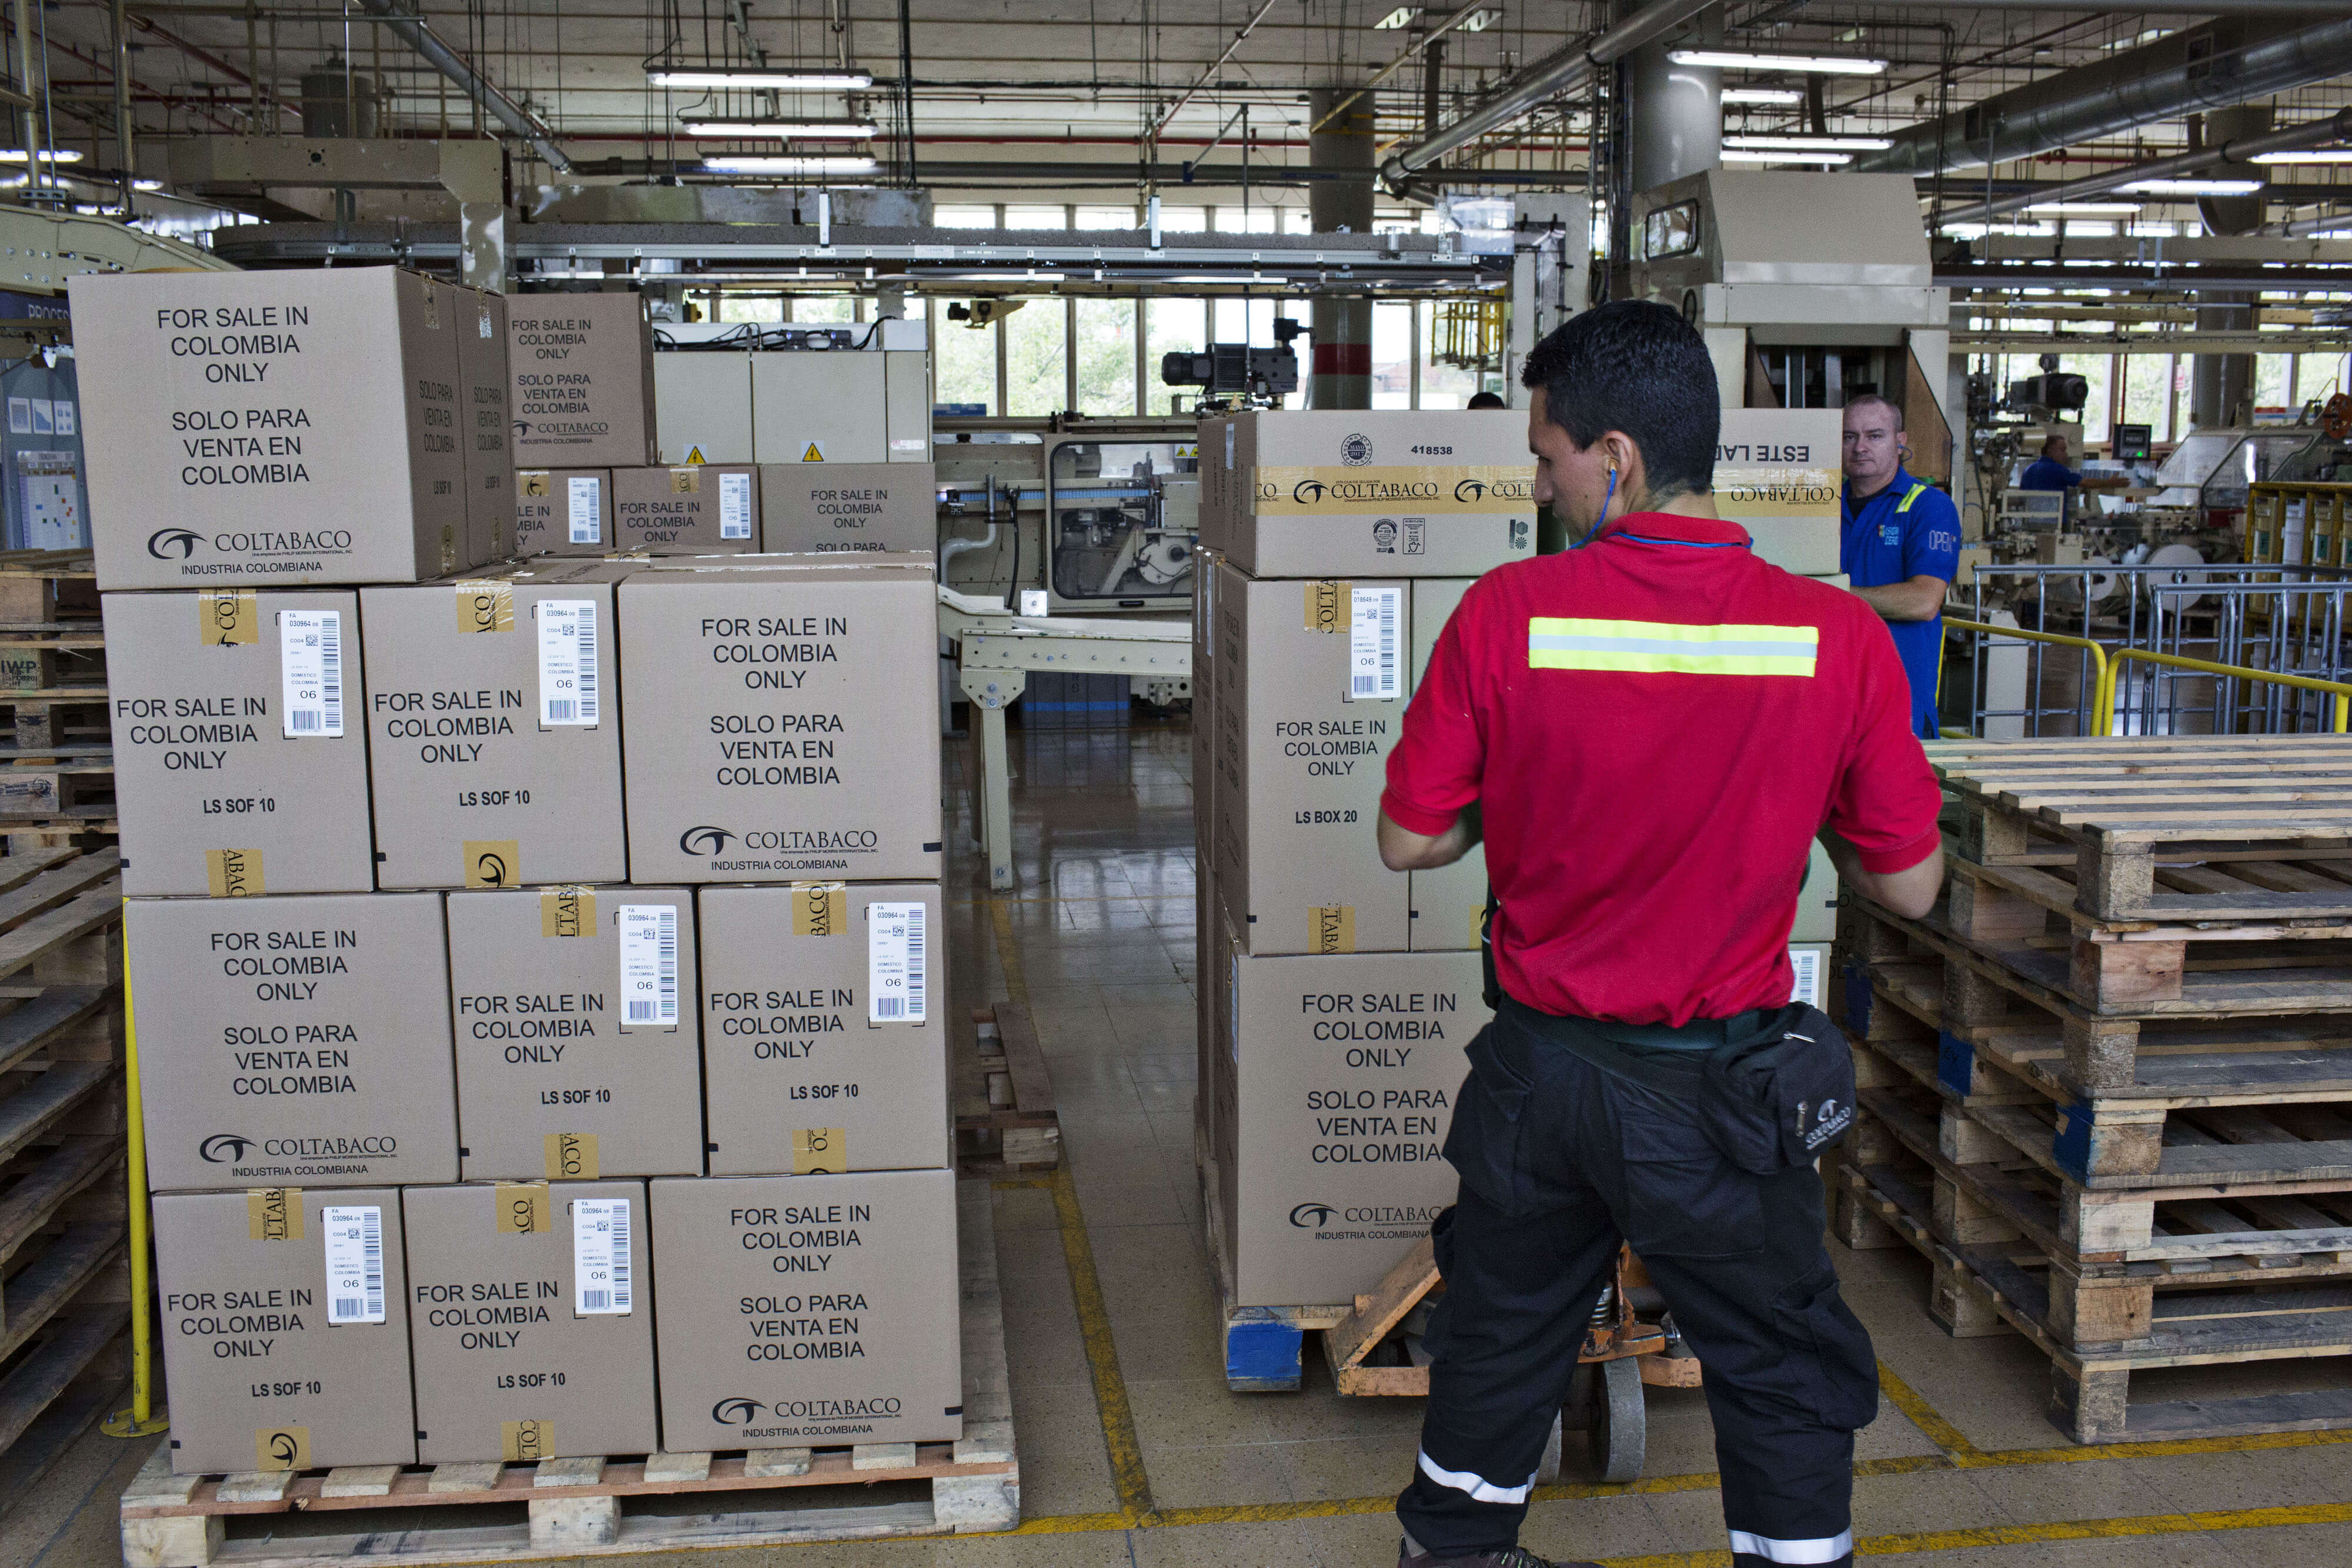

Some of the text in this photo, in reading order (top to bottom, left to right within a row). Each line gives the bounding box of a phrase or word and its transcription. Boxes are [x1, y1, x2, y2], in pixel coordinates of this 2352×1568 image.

[158, 306, 308, 329] FOR SALE IN
[512, 319, 591, 331] FOR SALE IN
[171, 334, 300, 356] COLOMBIA
[519, 334, 586, 345] COLOMBIA
[536, 348, 570, 359] ONLY
[205, 363, 269, 383] ONLY
[518, 374, 591, 386] SOLO PARA
[419, 380, 453, 403] SOLO PARA
[523, 388, 586, 400] VENTA EN
[423, 407, 443, 426] VENTA
[522, 402, 590, 414] COLOMBIA
[172, 409, 311, 431] SOLO PARA
[537, 422, 609, 433] COLTABACO
[183, 436, 301, 458] VENTA EN
[424, 434, 455, 452] COLOMBIA
[1411, 445, 1452, 455] 418538
[1716, 445, 1750, 462] LAD
[182, 463, 310, 486] COLOMBIA
[811, 490, 887, 501] FOR SALE IN
[1331, 483, 1438, 499] COLTABACO
[1491, 483, 1535, 498] COLT
[517, 506, 550, 517] LE IN
[620, 502, 700, 514] FOR SALE IN
[817, 503, 883, 514] COLOMBIA
[627, 516, 695, 529] COLOMBIA
[834, 517, 866, 529] ONLY
[215, 530, 352, 551] COLTABACO
[644, 531, 678, 542] ONLY
[182, 561, 323, 575] INDUSTRIA COLOMBIANA
[702, 617, 846, 637] FOR SALE IN
[713, 644, 837, 663] COLOMBIA
[557, 680, 572, 688] 06
[745, 670, 806, 689] ONLY
[300, 690, 316, 698] 06
[375, 690, 522, 712] FOR SALE IN
[117, 697, 266, 718] FOR SALE IN
[387, 716, 514, 738] COLOMBIA
[710, 714, 844, 734] SOLO PARA
[1277, 720, 1385, 737] FOR SALE IN
[131, 724, 258, 744] COLOMBIA
[421, 743, 483, 763] ONLY
[720, 740, 833, 760] VENTA EN
[1284, 740, 1378, 757] COLOMBIA
[164, 751, 226, 770] ONLY
[1308, 761, 1354, 776] ONLY
[717, 766, 840, 785] COLOMBIA
[203, 798, 275, 814] LS SOF 10
[1295, 810, 1357, 824] LS BOX 20
[746, 830, 877, 849] COLTABACO
[211, 930, 356, 951] FOR SALE IN
[224, 956, 348, 977] COLOMBIA
[256, 982, 318, 1001] ONLY
[637, 981, 653, 989] 06
[886, 978, 901, 987] 06
[460, 994, 603, 1014] FOR SALE IN
[711, 989, 853, 1011] FOR SALE IN
[1302, 993, 1455, 1014] FOR SALE IN
[472, 1019, 595, 1039] COLOMBIA
[723, 1014, 844, 1035] COLOMBIA
[1314, 1021, 1445, 1041] COLOMBIA
[505, 1045, 565, 1064] ONLY
[754, 1040, 814, 1059] ONLY
[1346, 1048, 1411, 1068] ONLY
[542, 1089, 610, 1105] LS SOF 10
[265, 1136, 396, 1156] COLTABACO
[731, 1205, 870, 1226] FOR SALE IN
[1345, 1206, 1442, 1222] COLTABAC
[743, 1229, 861, 1250] COLOMBIA
[1315, 1230, 1429, 1240] INDUSTRIA COLOMBIANA
[773, 1254, 831, 1273] ONLY
[343, 1279, 359, 1288] 06
[591, 1271, 607, 1280] 06
[417, 1281, 558, 1303] FOR SALE IN
[429, 1306, 550, 1327] COLOMBIA
[461, 1330, 520, 1349] ONLY
[775, 1398, 901, 1417] COLTABACO
